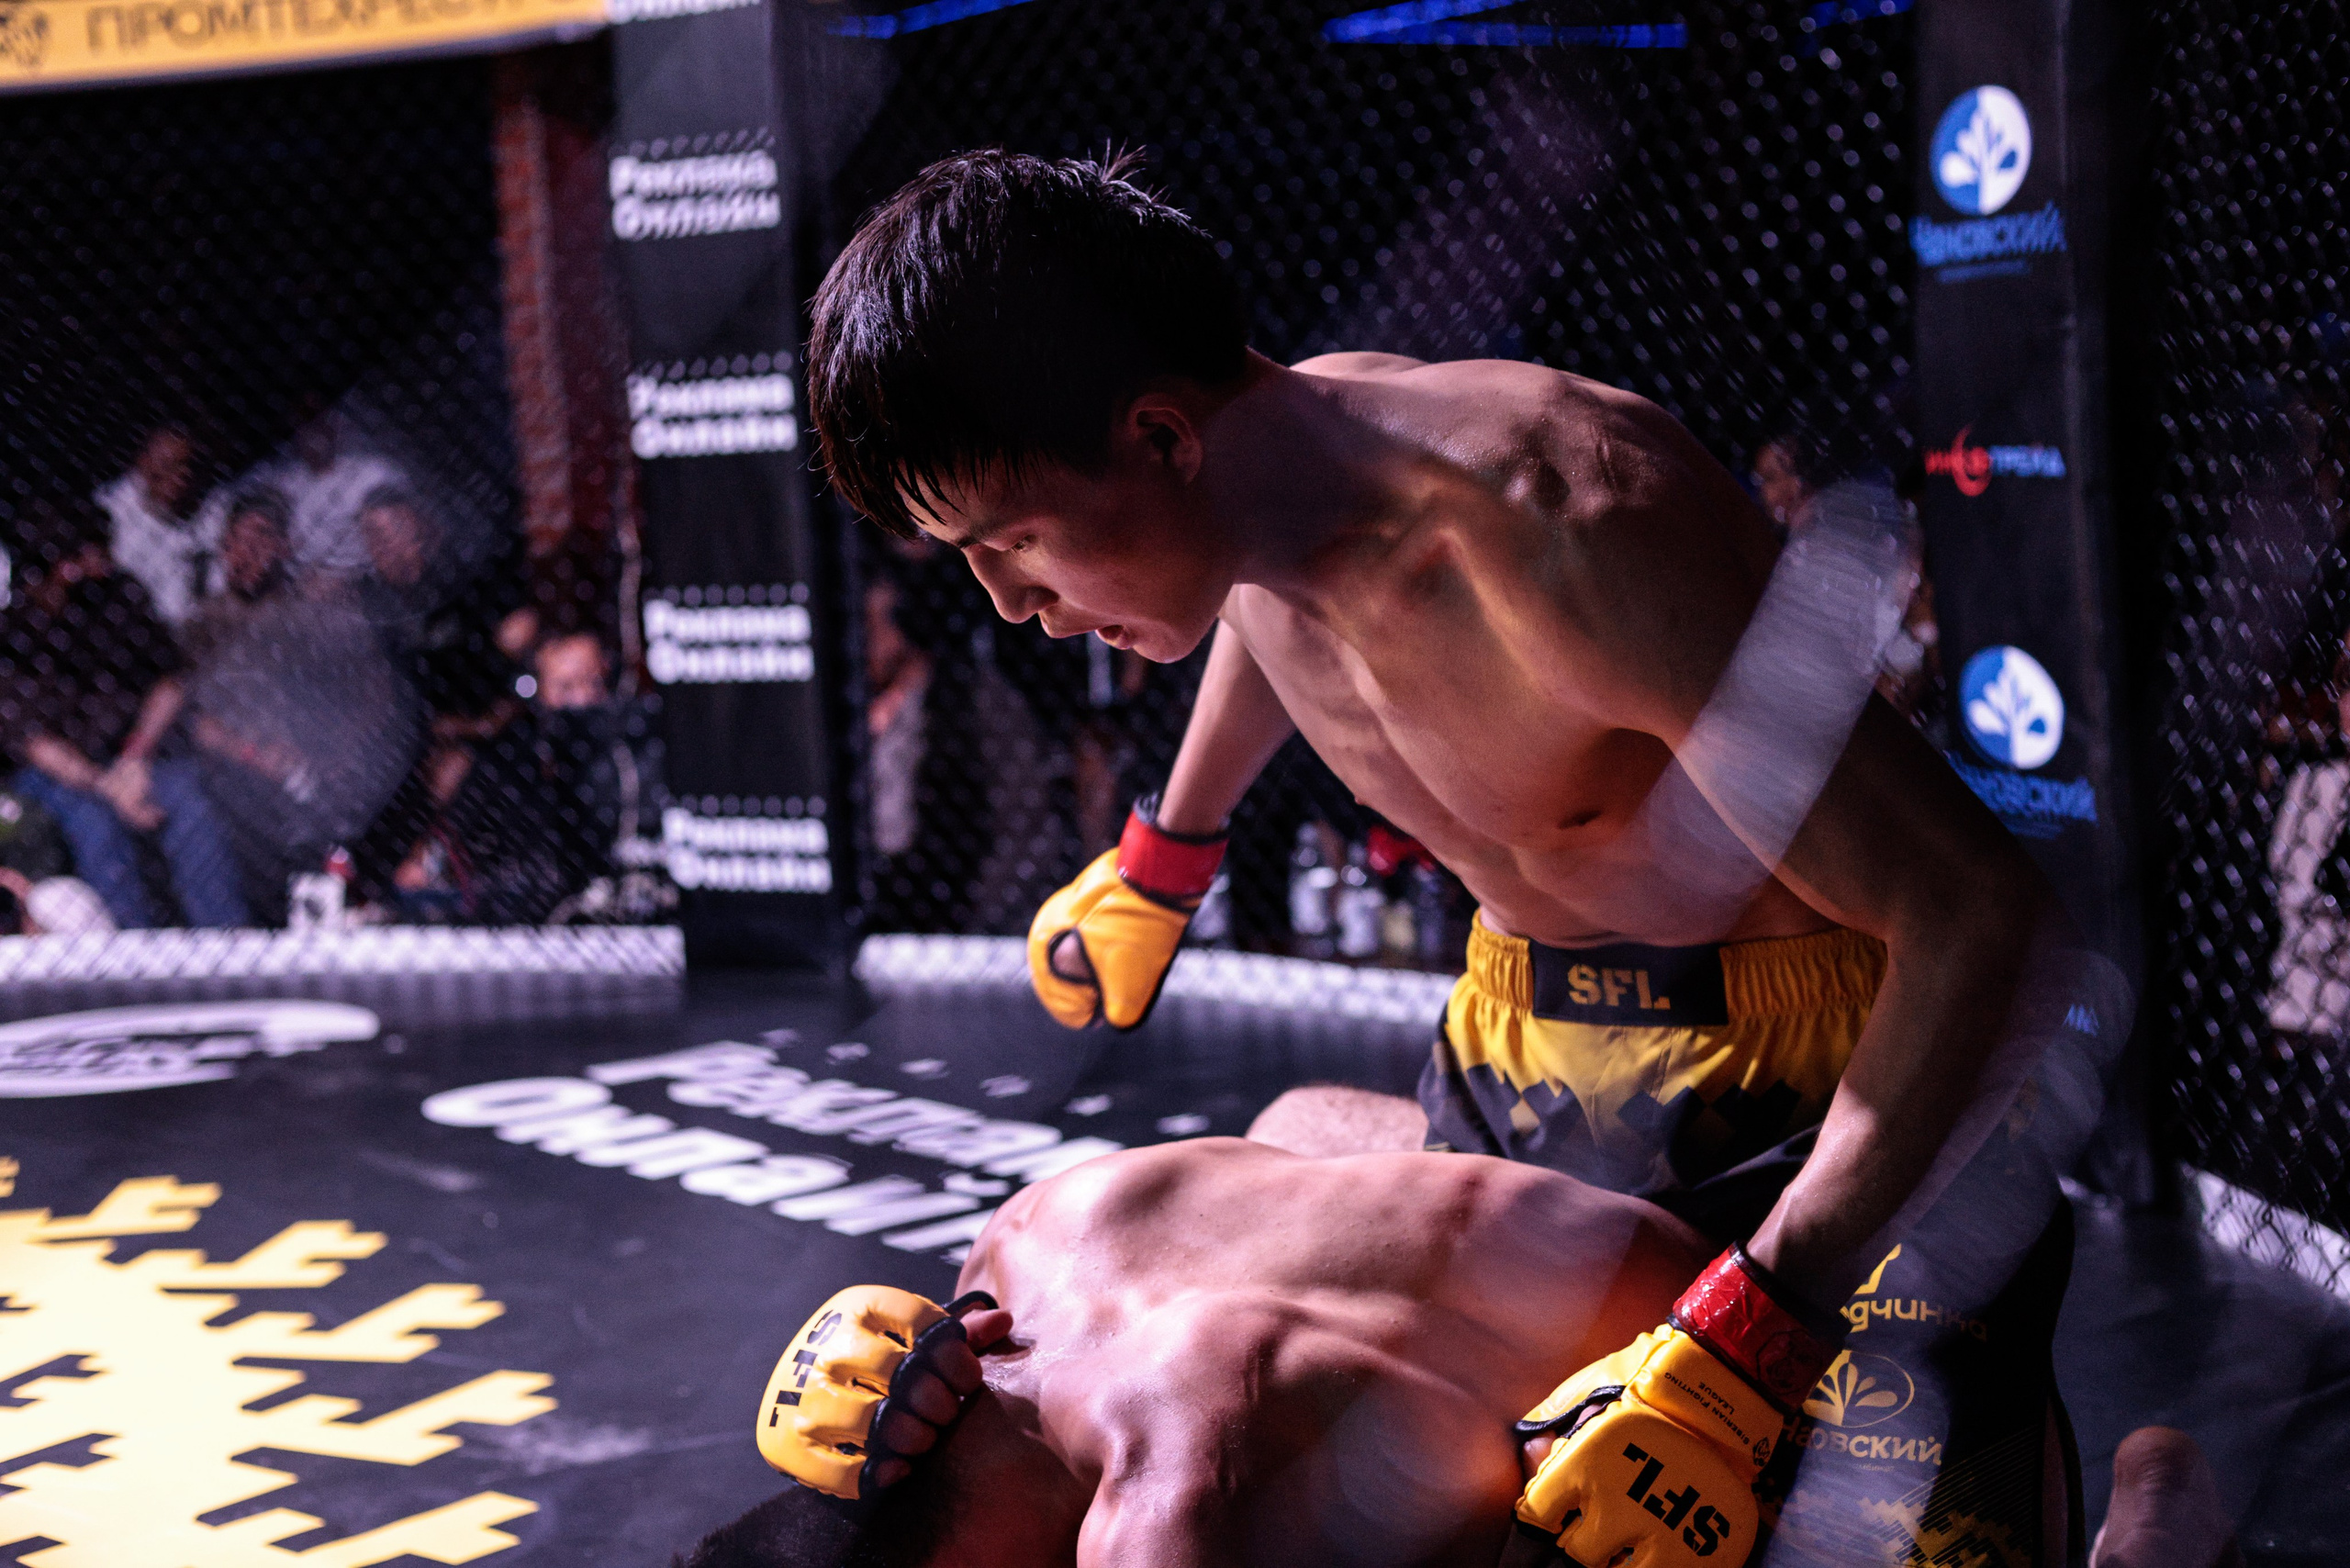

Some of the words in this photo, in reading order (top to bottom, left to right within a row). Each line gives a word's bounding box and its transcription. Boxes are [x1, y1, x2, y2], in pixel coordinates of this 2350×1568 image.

[1567, 964, 1671, 1010] SFL
[769, 1309, 842, 1428] SFL
[1622, 1442, 1730, 1557] SFL
